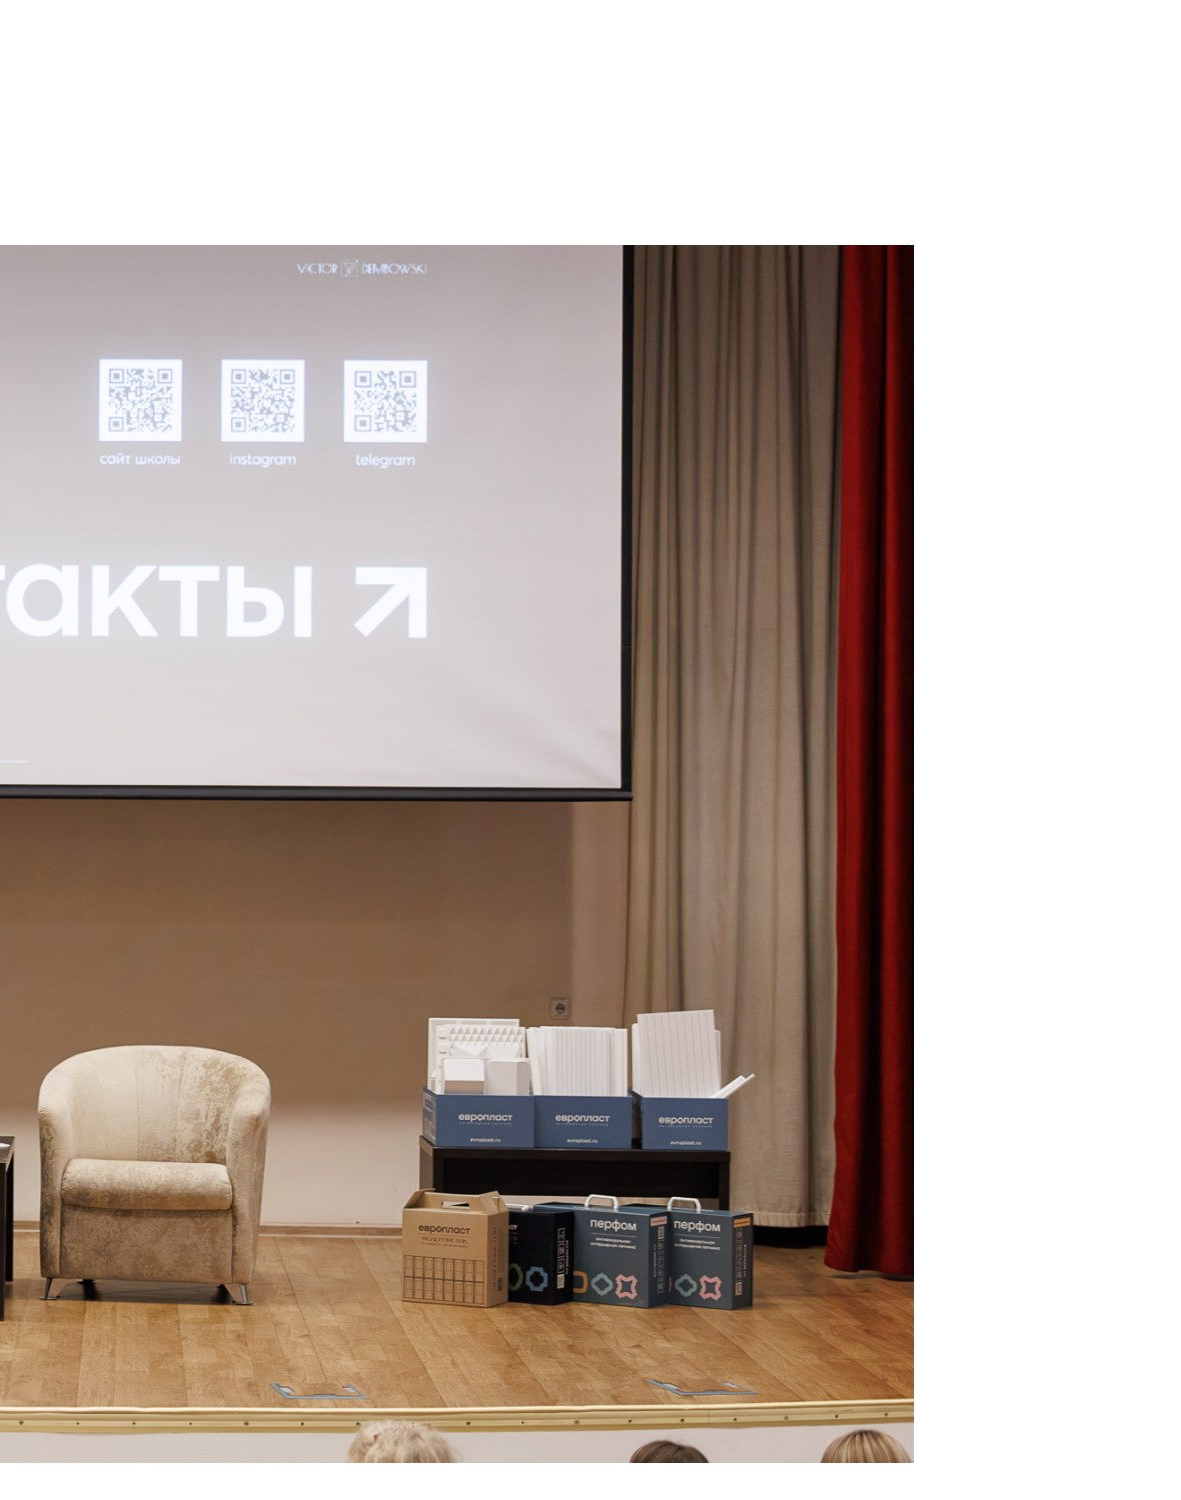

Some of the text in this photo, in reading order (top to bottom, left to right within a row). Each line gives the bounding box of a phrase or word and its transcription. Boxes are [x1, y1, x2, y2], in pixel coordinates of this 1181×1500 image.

[297, 262, 339, 275] VICTOR
[99, 452, 181, 466] сайт школы
[229, 452, 297, 468] instagram
[355, 453, 416, 469] telegram
[458, 1113, 514, 1123] европласт
[555, 1114, 611, 1124] европласт
[658, 1116, 715, 1126] европласт
[418, 1223, 472, 1235] европласт
[590, 1218, 638, 1233] перфом
[673, 1220, 722, 1234] перфом
